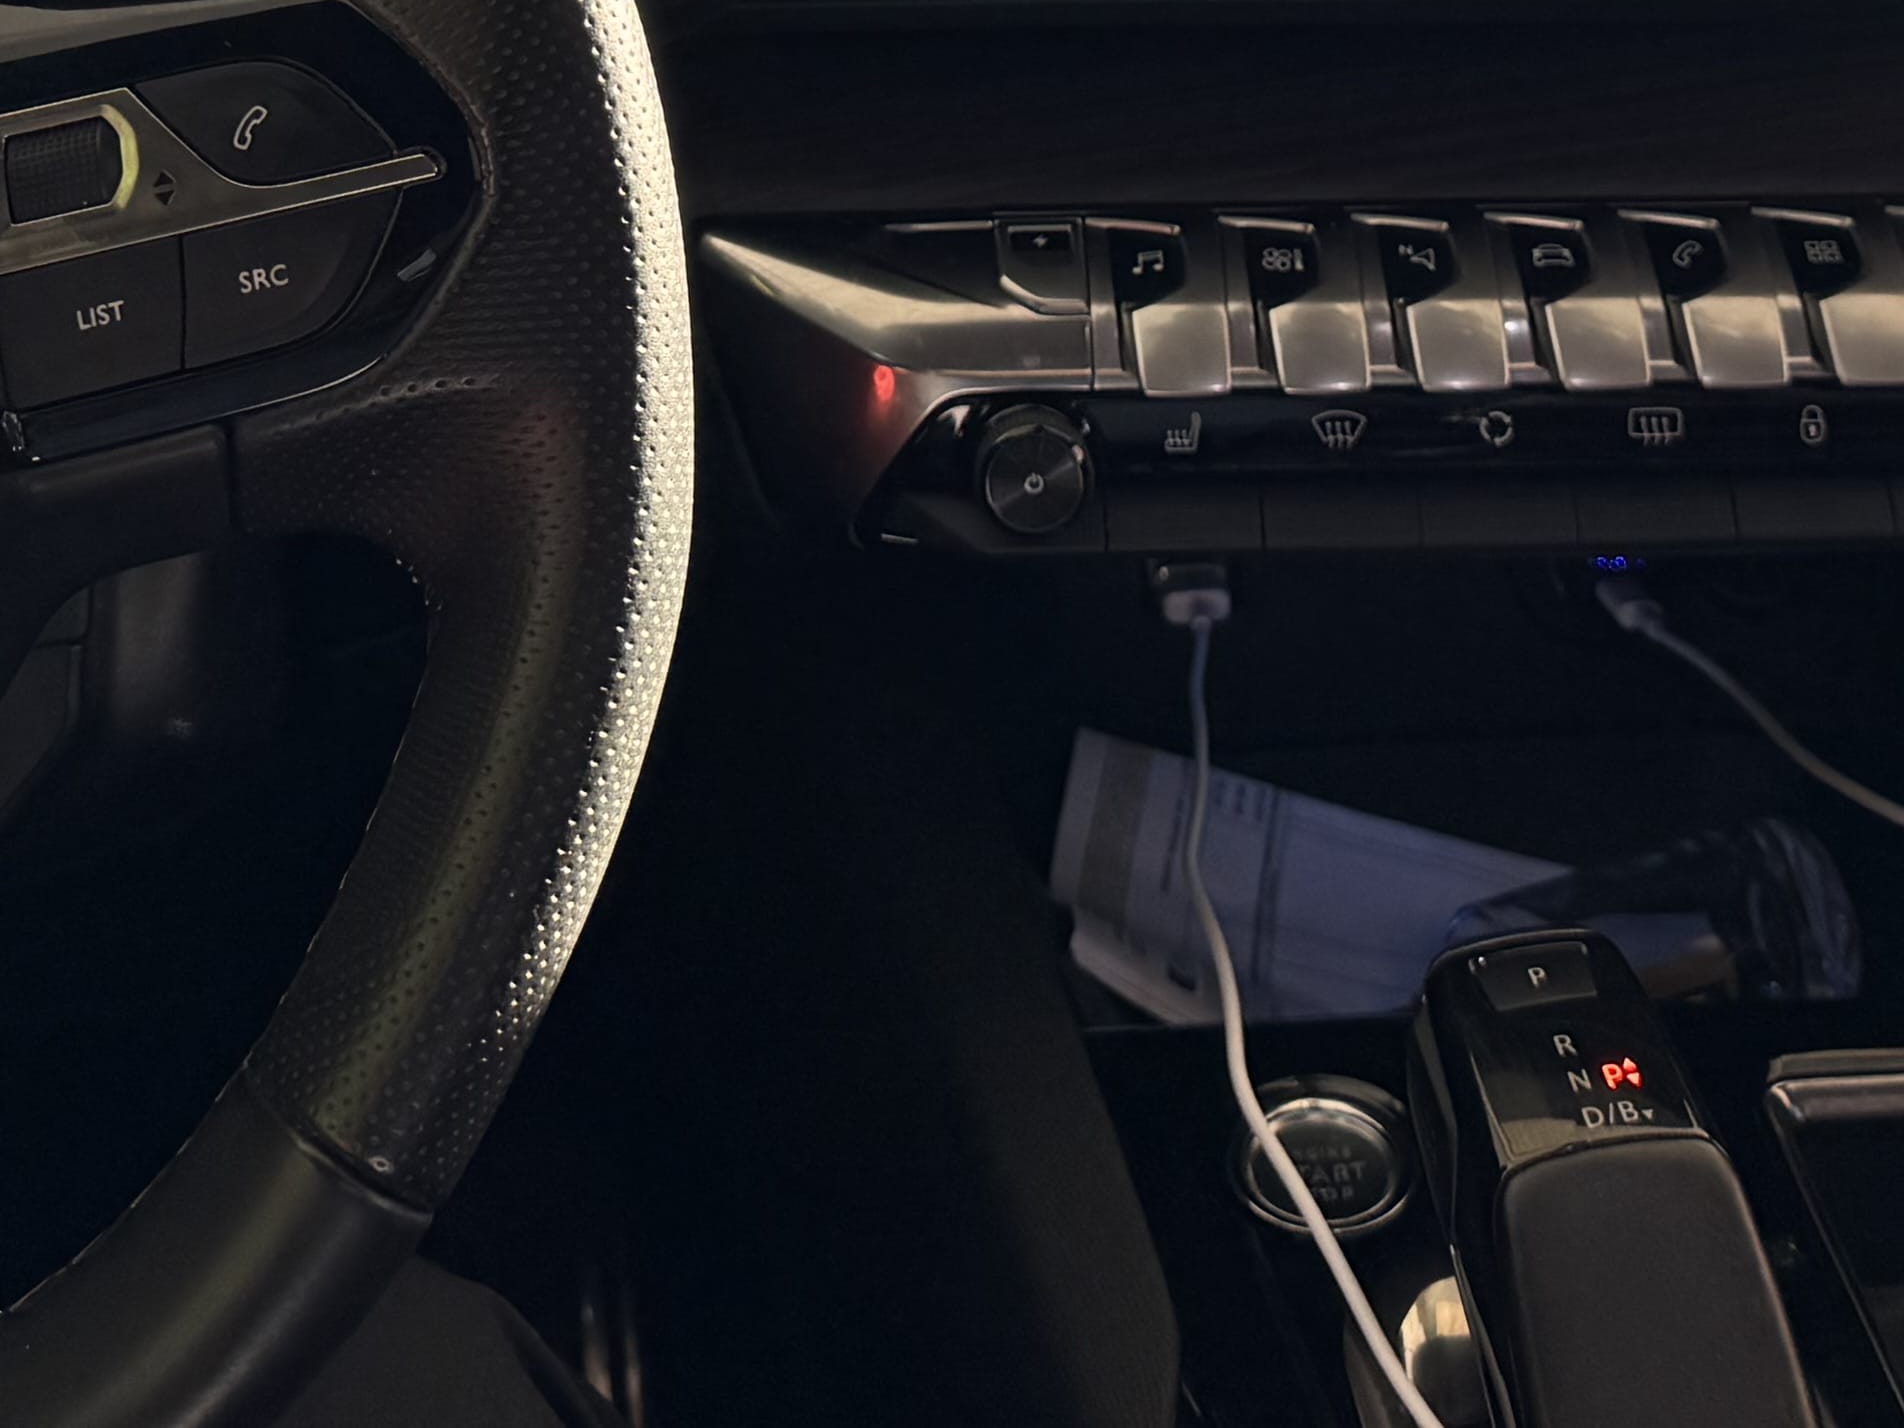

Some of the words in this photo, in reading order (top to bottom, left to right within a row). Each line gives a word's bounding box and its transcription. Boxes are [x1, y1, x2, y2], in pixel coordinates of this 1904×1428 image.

[238, 264, 289, 294] SRC
[76, 300, 124, 330] LIST
[1527, 967, 1546, 988] P
[1553, 1034, 1578, 1057] R
[1567, 1068, 1592, 1093] N
[1601, 1063, 1623, 1090] P
[1581, 1100, 1639, 1128] D/B
[1299, 1161, 1367, 1184] TART
